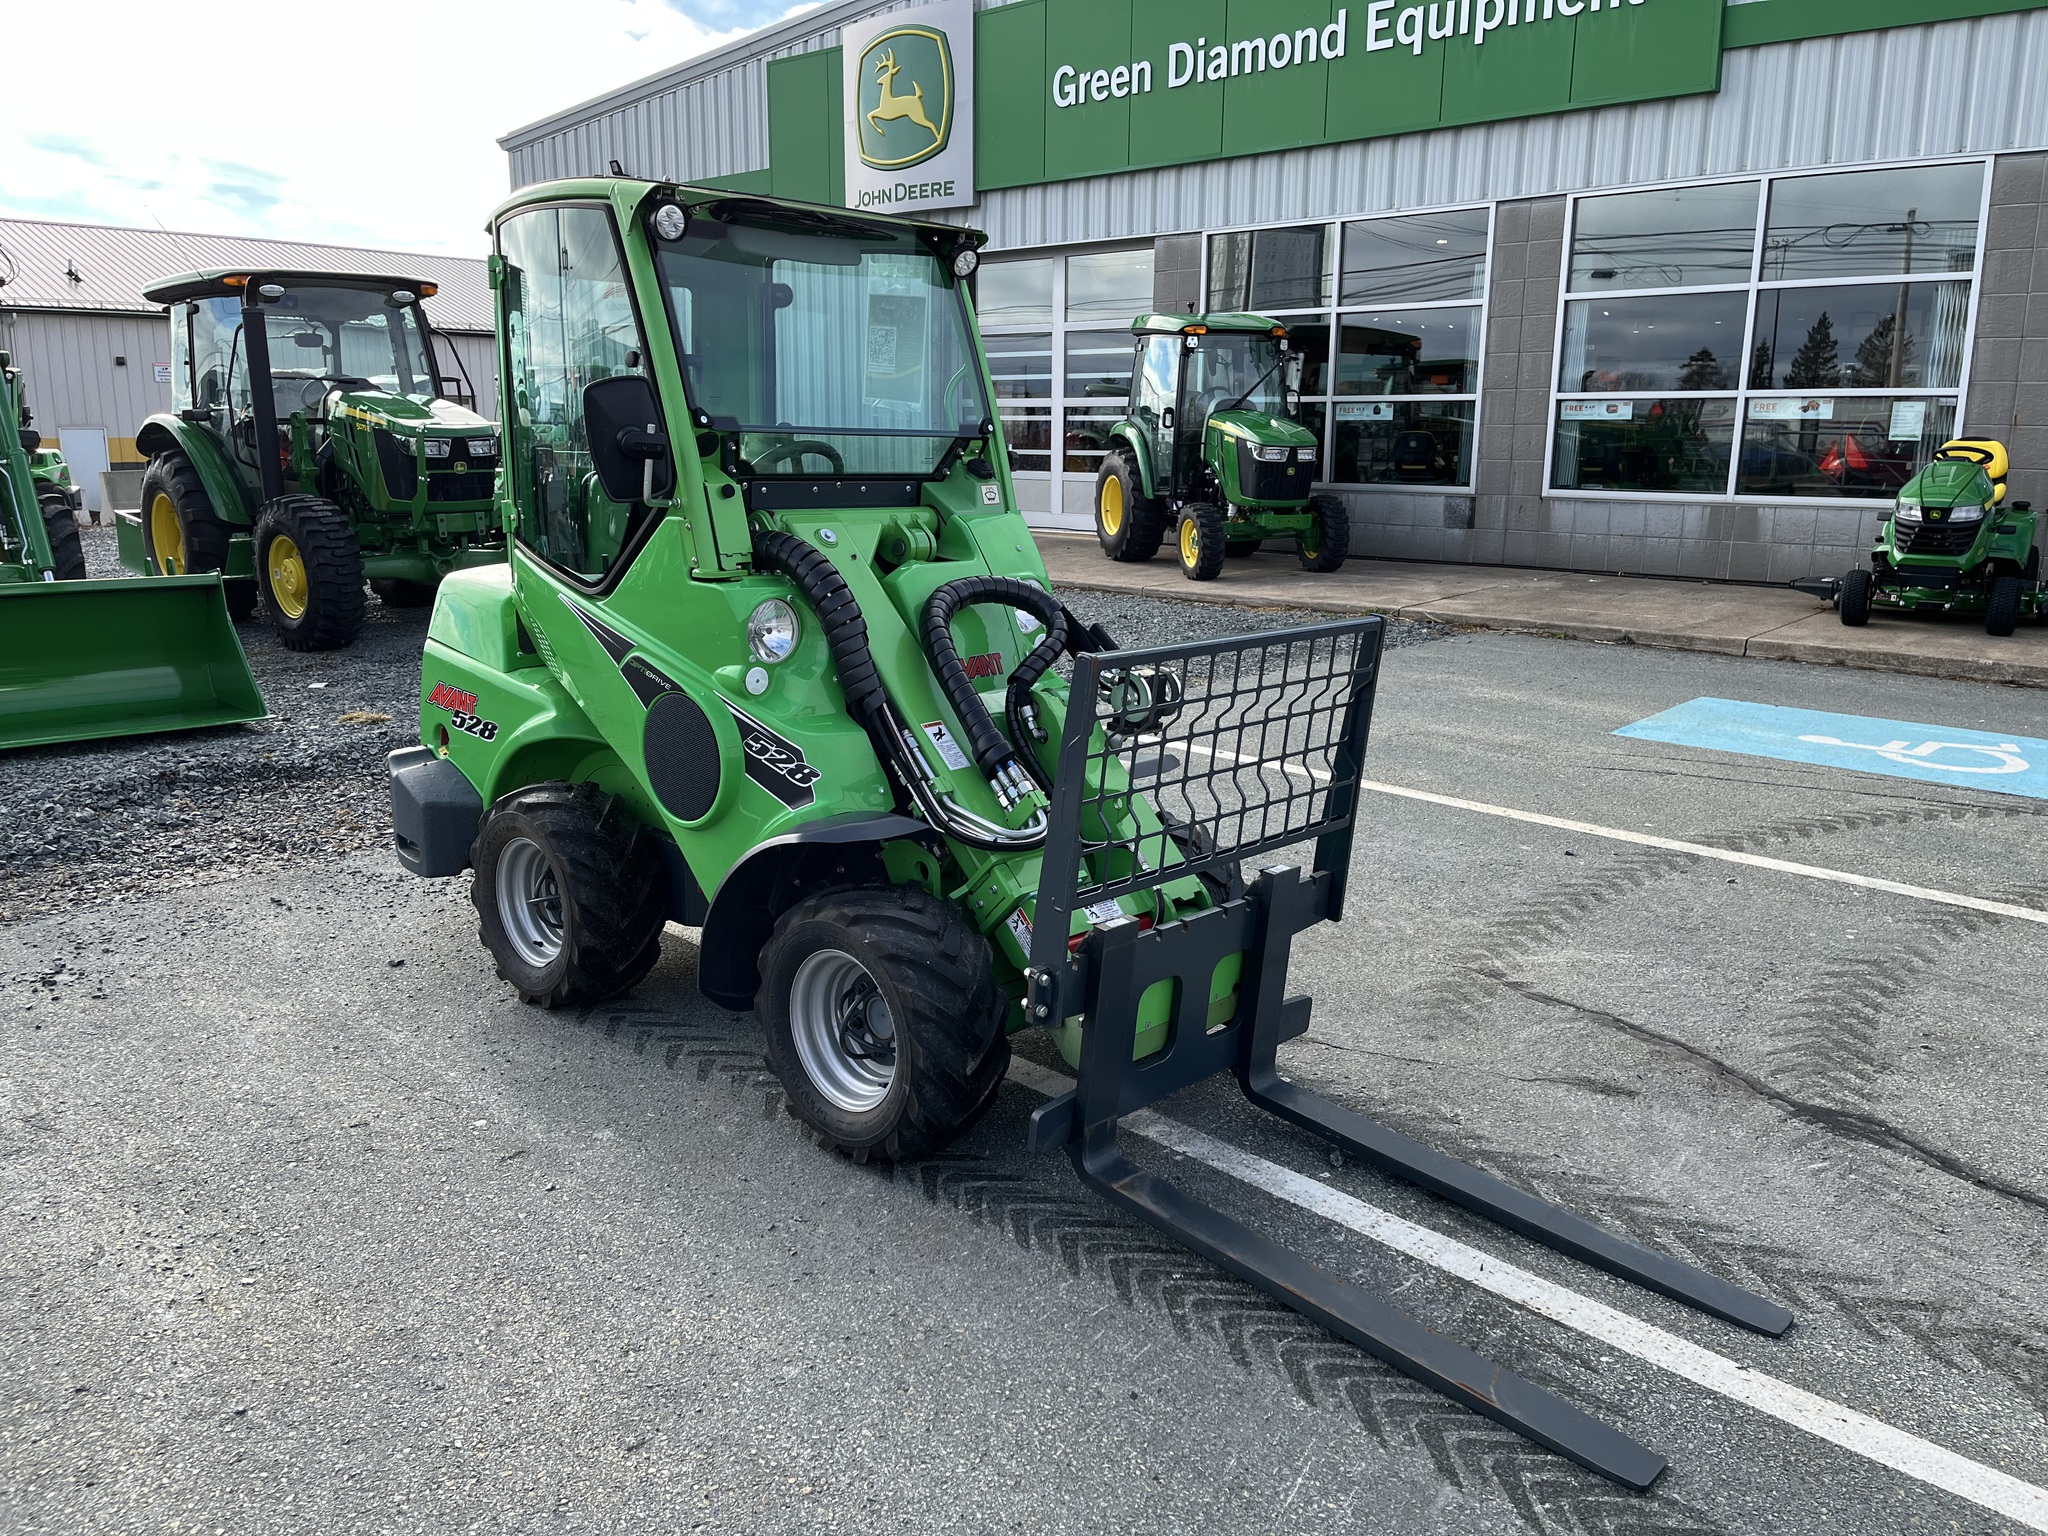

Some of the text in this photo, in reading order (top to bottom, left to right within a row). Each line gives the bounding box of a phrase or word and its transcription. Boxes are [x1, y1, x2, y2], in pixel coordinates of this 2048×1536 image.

[1052, 60, 1152, 108] Green
[1168, 8, 1347, 89] Diamond
[855, 180, 955, 209] JOHN DEERE
[1564, 404, 1584, 412] FREE
[959, 652, 1004, 679] VANT
[426, 681, 479, 715] AVANT
[450, 708, 499, 742] 528
[743, 731, 822, 787] 528
